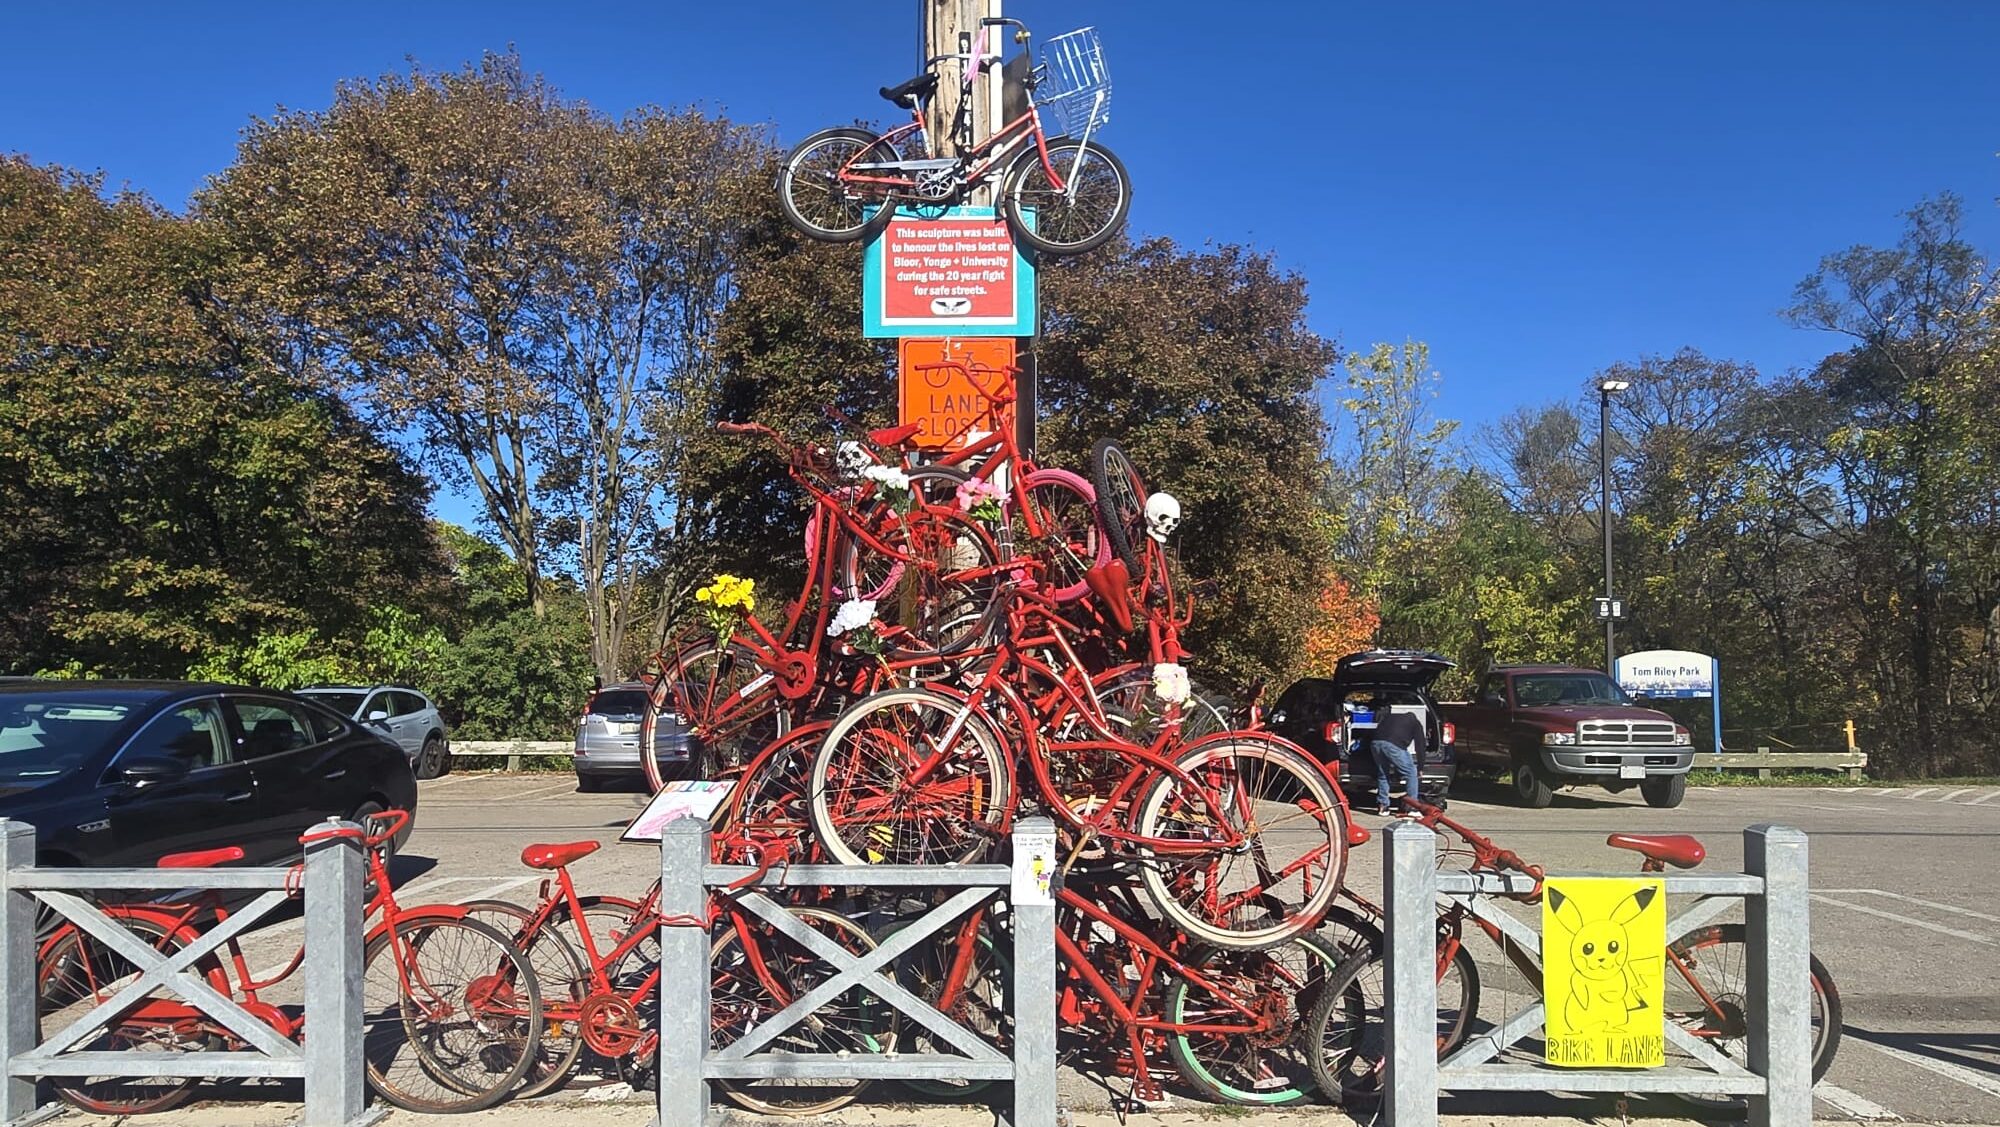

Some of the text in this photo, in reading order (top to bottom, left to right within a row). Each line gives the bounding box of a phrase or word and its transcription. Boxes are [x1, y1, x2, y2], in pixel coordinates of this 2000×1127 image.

[896, 227, 1006, 240] This sculpture was built
[892, 241, 1010, 253] to honour the lives lost on
[893, 257, 922, 268] Bloor,
[923, 257, 952, 269] Yonge
[961, 256, 1009, 268] University
[896, 270, 1006, 283] during the 20 year fight
[914, 284, 988, 296] for safe streets.
[930, 394, 985, 414] LANE
[1632, 666, 1700, 678] Tom Riley Park
